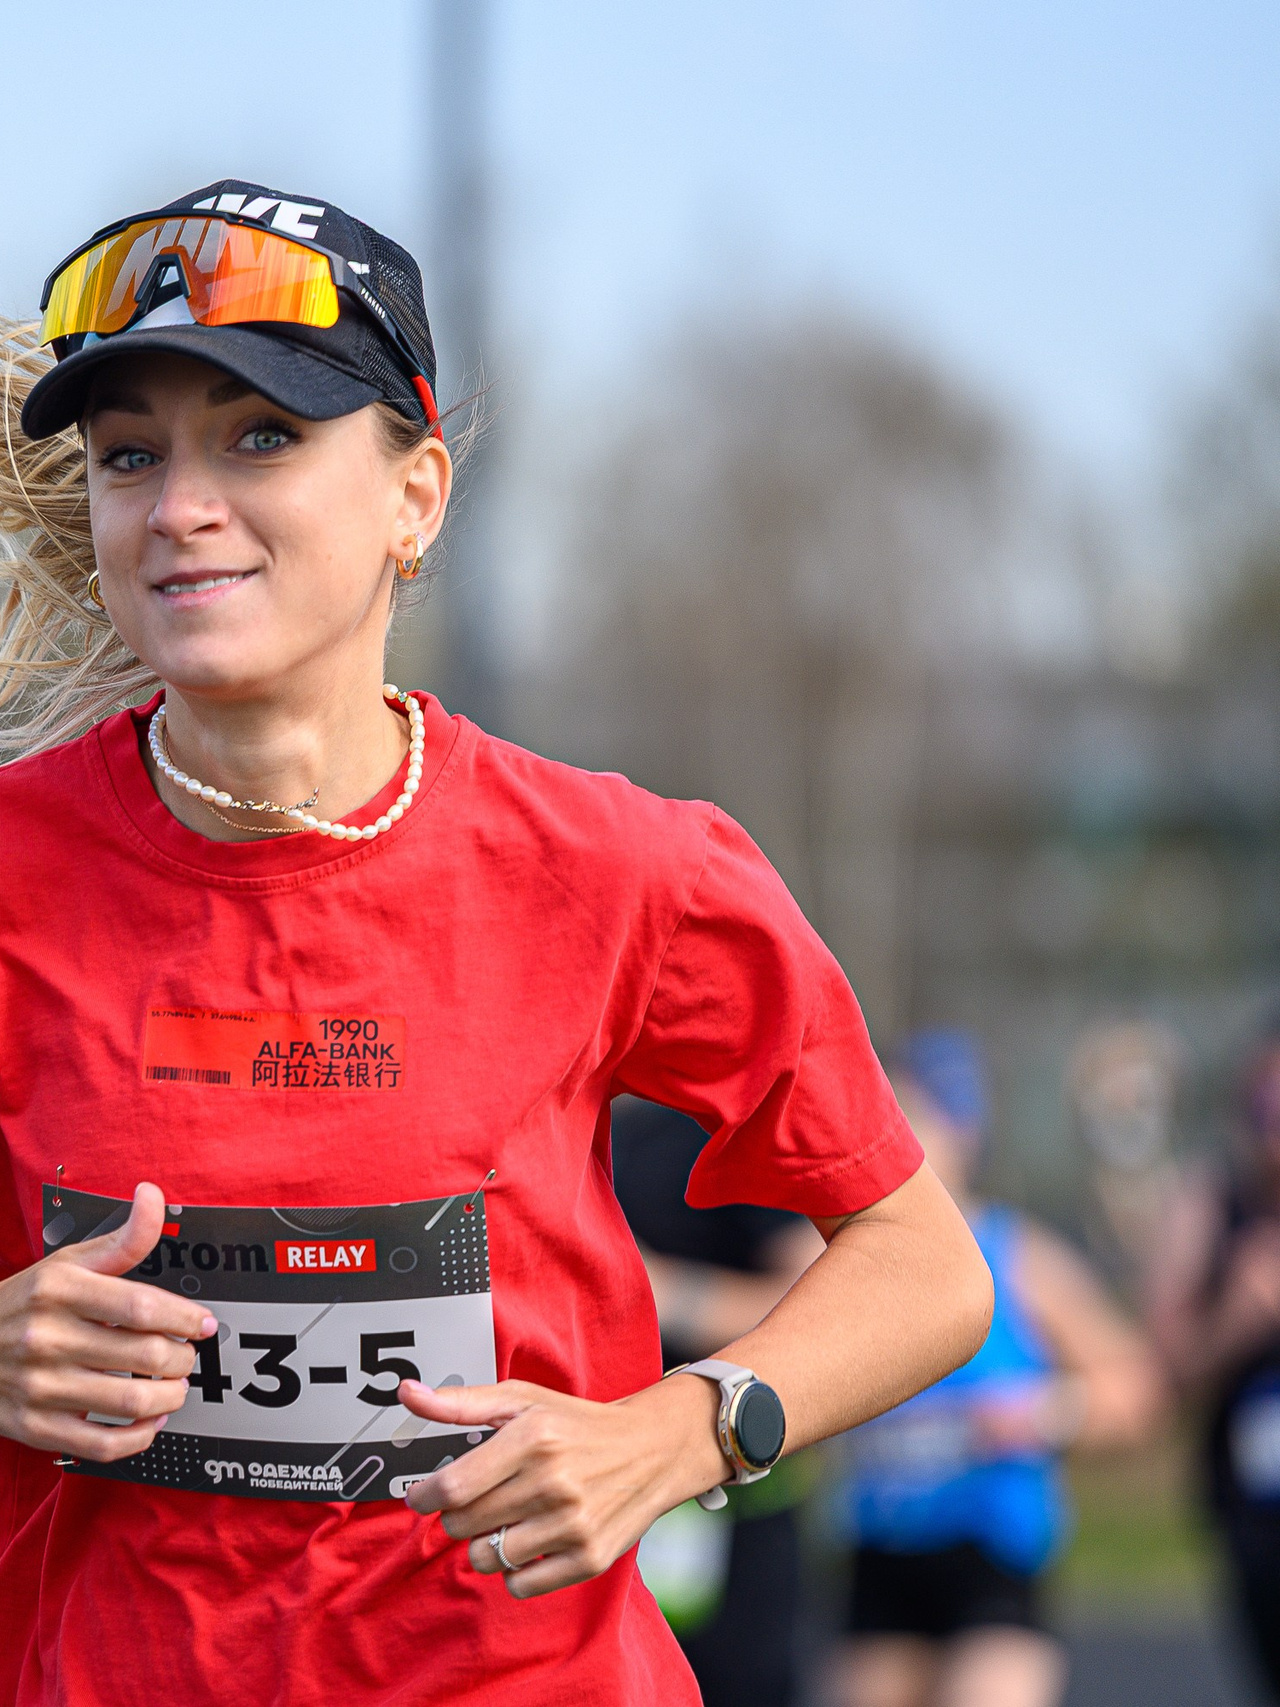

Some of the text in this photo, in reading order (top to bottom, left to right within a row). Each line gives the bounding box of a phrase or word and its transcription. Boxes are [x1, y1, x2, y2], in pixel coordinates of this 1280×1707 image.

[318, 1019, 378, 1041] 1990
[258, 1041, 395, 1060] ALFA-BANK
[252, 1060, 402, 1088] 阿拉法银行
[286, 1244, 367, 1268] RELAY
[131, 1330, 421, 1408] 43-5
[248, 1462, 344, 1480] ОДЕЖДА
[250, 1478, 343, 1491] ПОБЕДИТЕЛЕЙ
